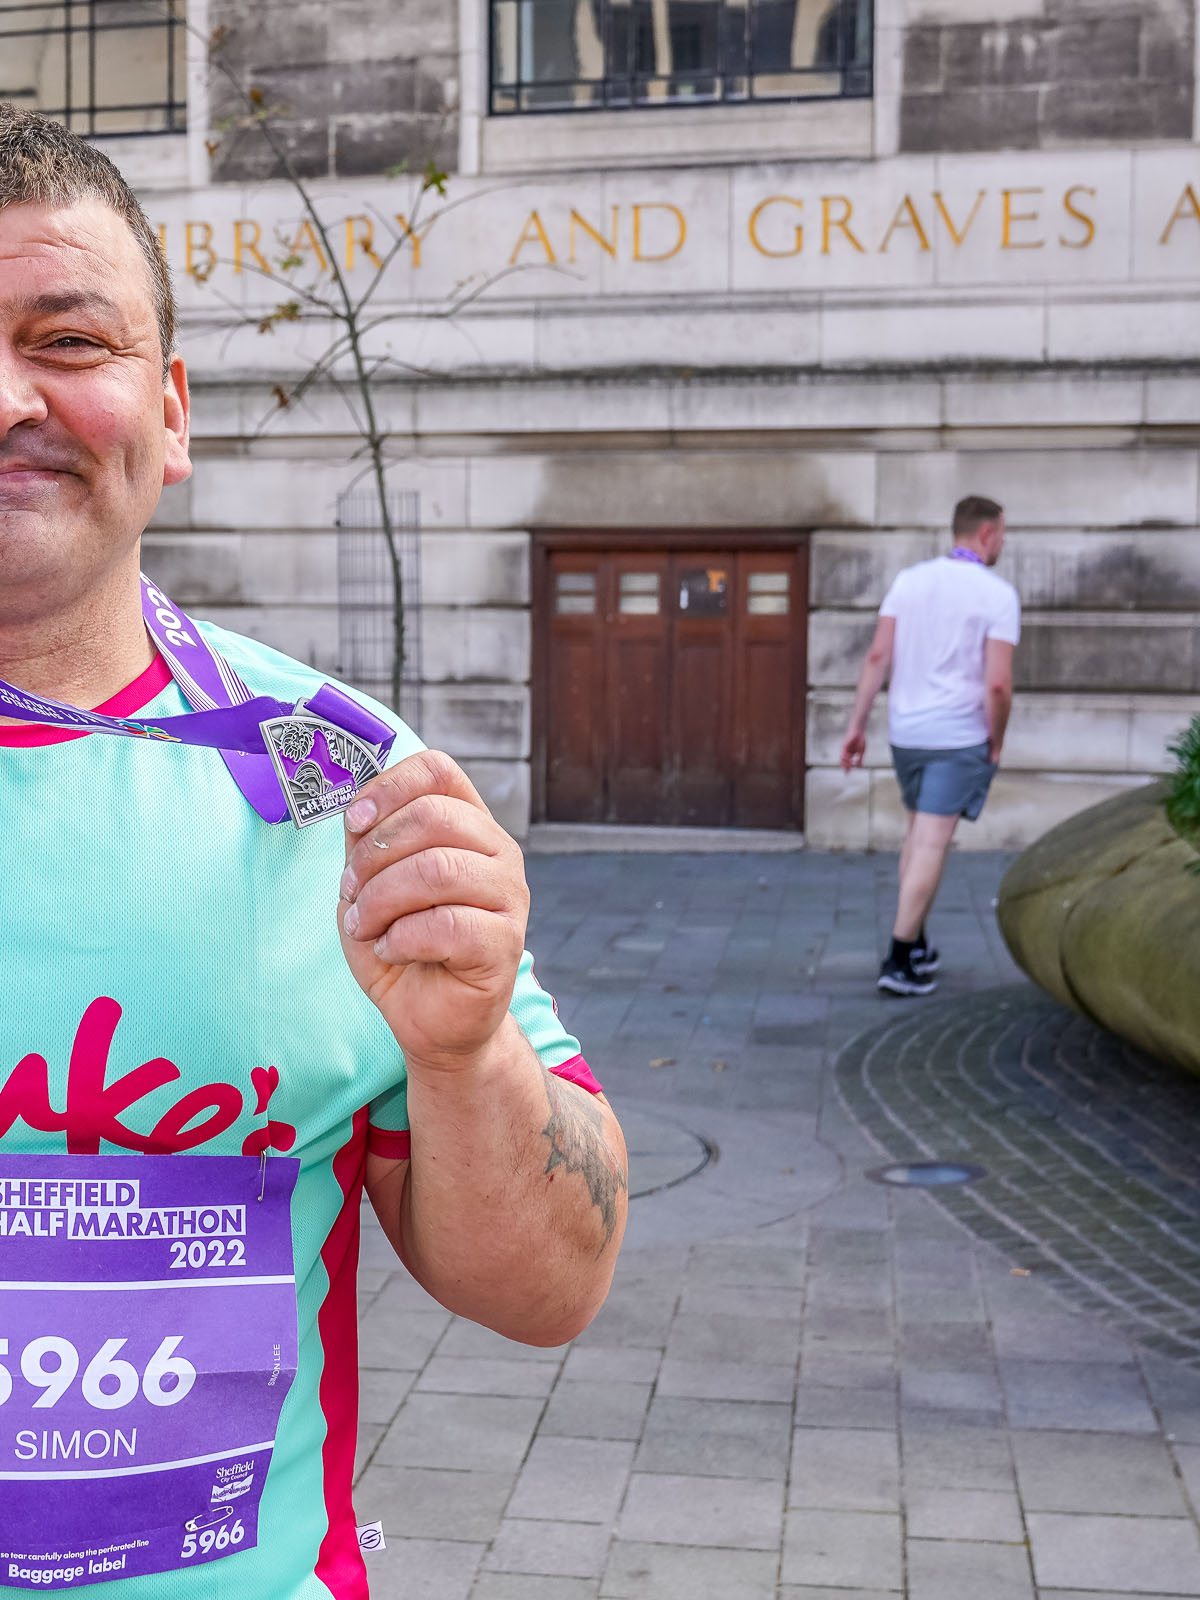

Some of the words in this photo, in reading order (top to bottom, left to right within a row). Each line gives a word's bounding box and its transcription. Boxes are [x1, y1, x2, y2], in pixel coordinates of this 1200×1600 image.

[508, 203, 688, 265] AND
[747, 184, 1097, 258] GRAVES
[318, 784, 352, 803] SHEFFIELD
[321, 799, 340, 811] HALF
[72, 1209, 242, 1238] MARATHON
[169, 1239, 247, 1269] 2022
[268, 1363, 280, 1386] SIMON
[13, 1428, 138, 1461] SIMON
[216, 1459, 255, 1479] Sheffield
[10, 1552, 28, 1560] tear
[27, 1552, 63, 1562] carefully
[63, 1551, 85, 1560] along
[85, 1548, 98, 1557] the
[98, 1542, 136, 1556] perforated
[136, 1539, 150, 1548] line
[181, 1518, 245, 1558] 5966
[8, 1563, 84, 1584] Baggage
[88, 1554, 127, 1575] label
